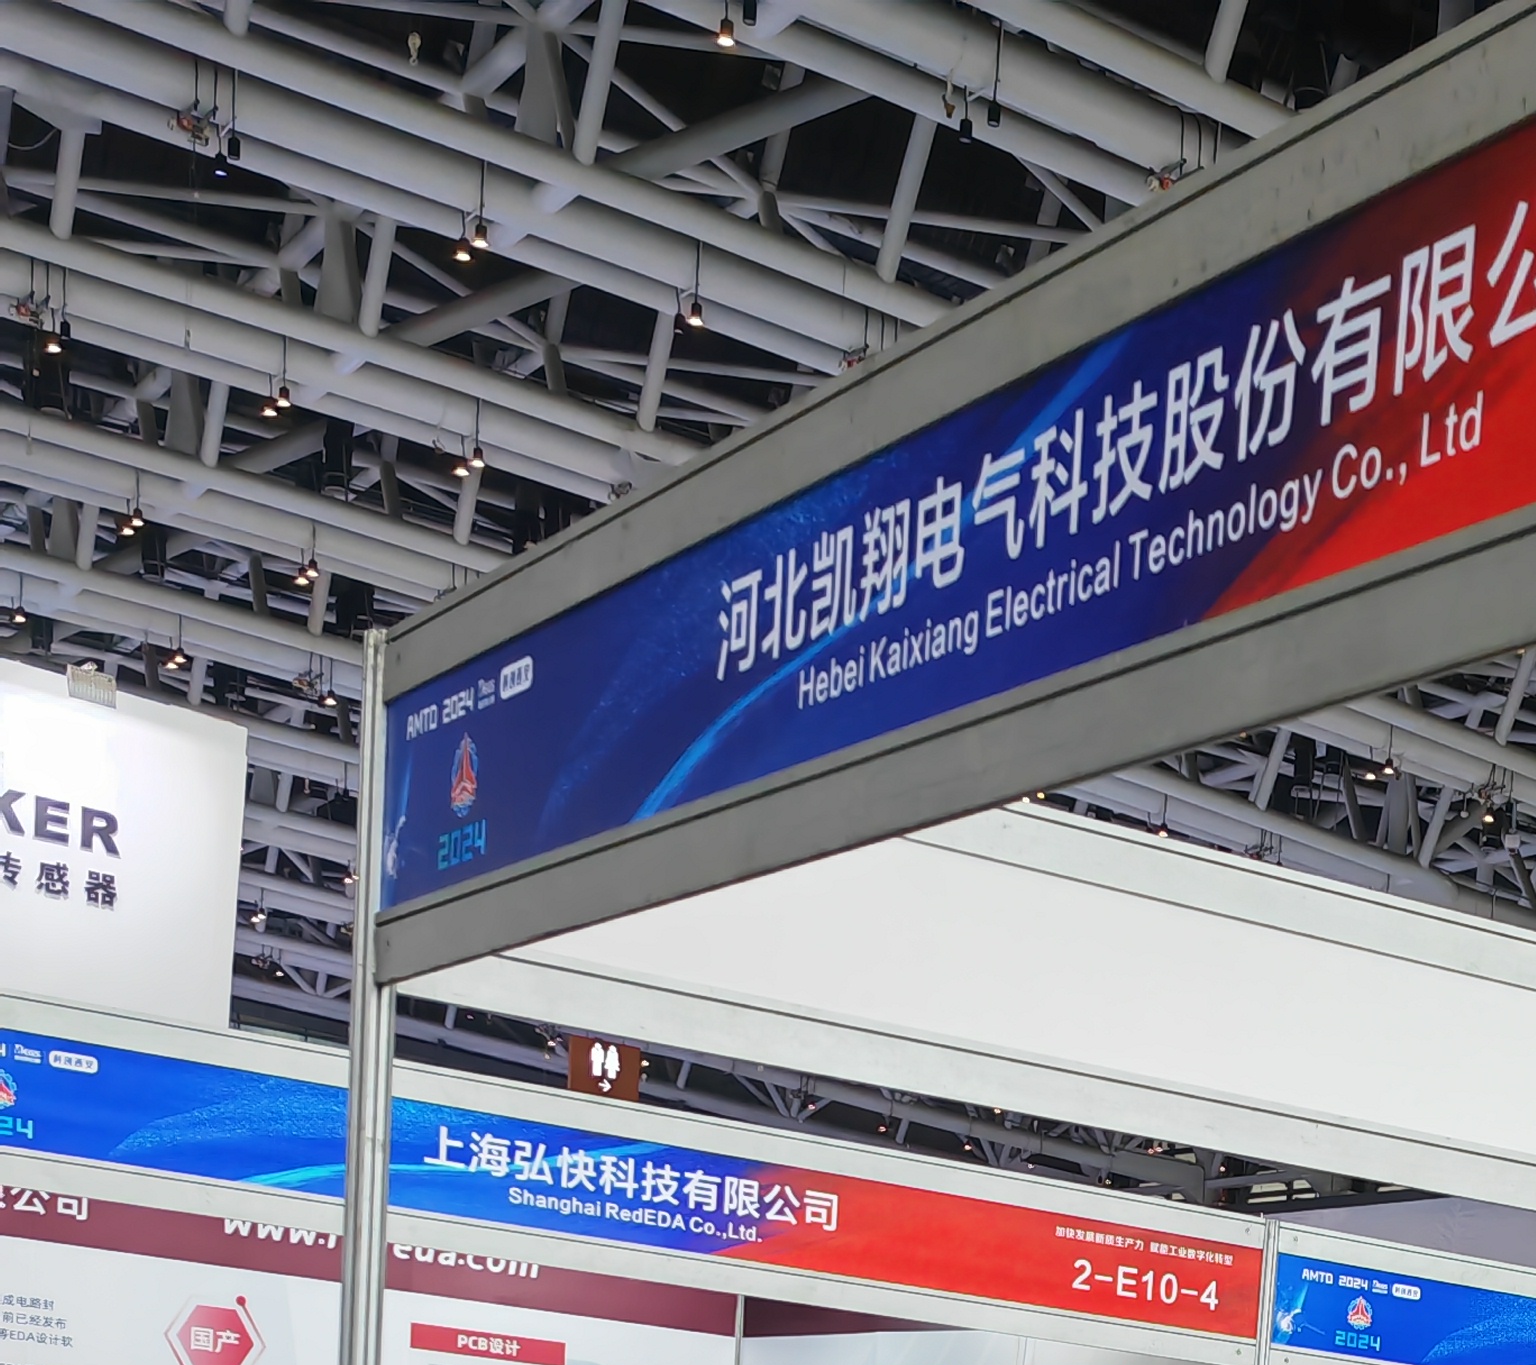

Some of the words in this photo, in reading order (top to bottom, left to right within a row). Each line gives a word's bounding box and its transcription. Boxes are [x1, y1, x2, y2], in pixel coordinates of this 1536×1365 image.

[797, 657, 865, 711] Hebei
[868, 605, 980, 682] Kaixiang
[986, 552, 1121, 636] Electrical
[1129, 468, 1323, 577] Technology
[1331, 441, 1409, 499] Co.,
[1418, 392, 1485, 470] Ltd
[442, 686, 475, 724] 2024
[437, 818, 488, 871] 2024
[423, 1125, 839, 1232] 上海弘快科技有限公司
[508, 1186, 602, 1218] Shanghai
[605, 1202, 687, 1231] RedEDA
[1071, 1258, 1220, 1311] 2-E10-4
[1338, 1275, 1369, 1291] 2024
[190, 1326, 241, 1353] 国产
[456, 1334, 521, 1358] PCB设计
[1334, 1330, 1381, 1352] 2024
